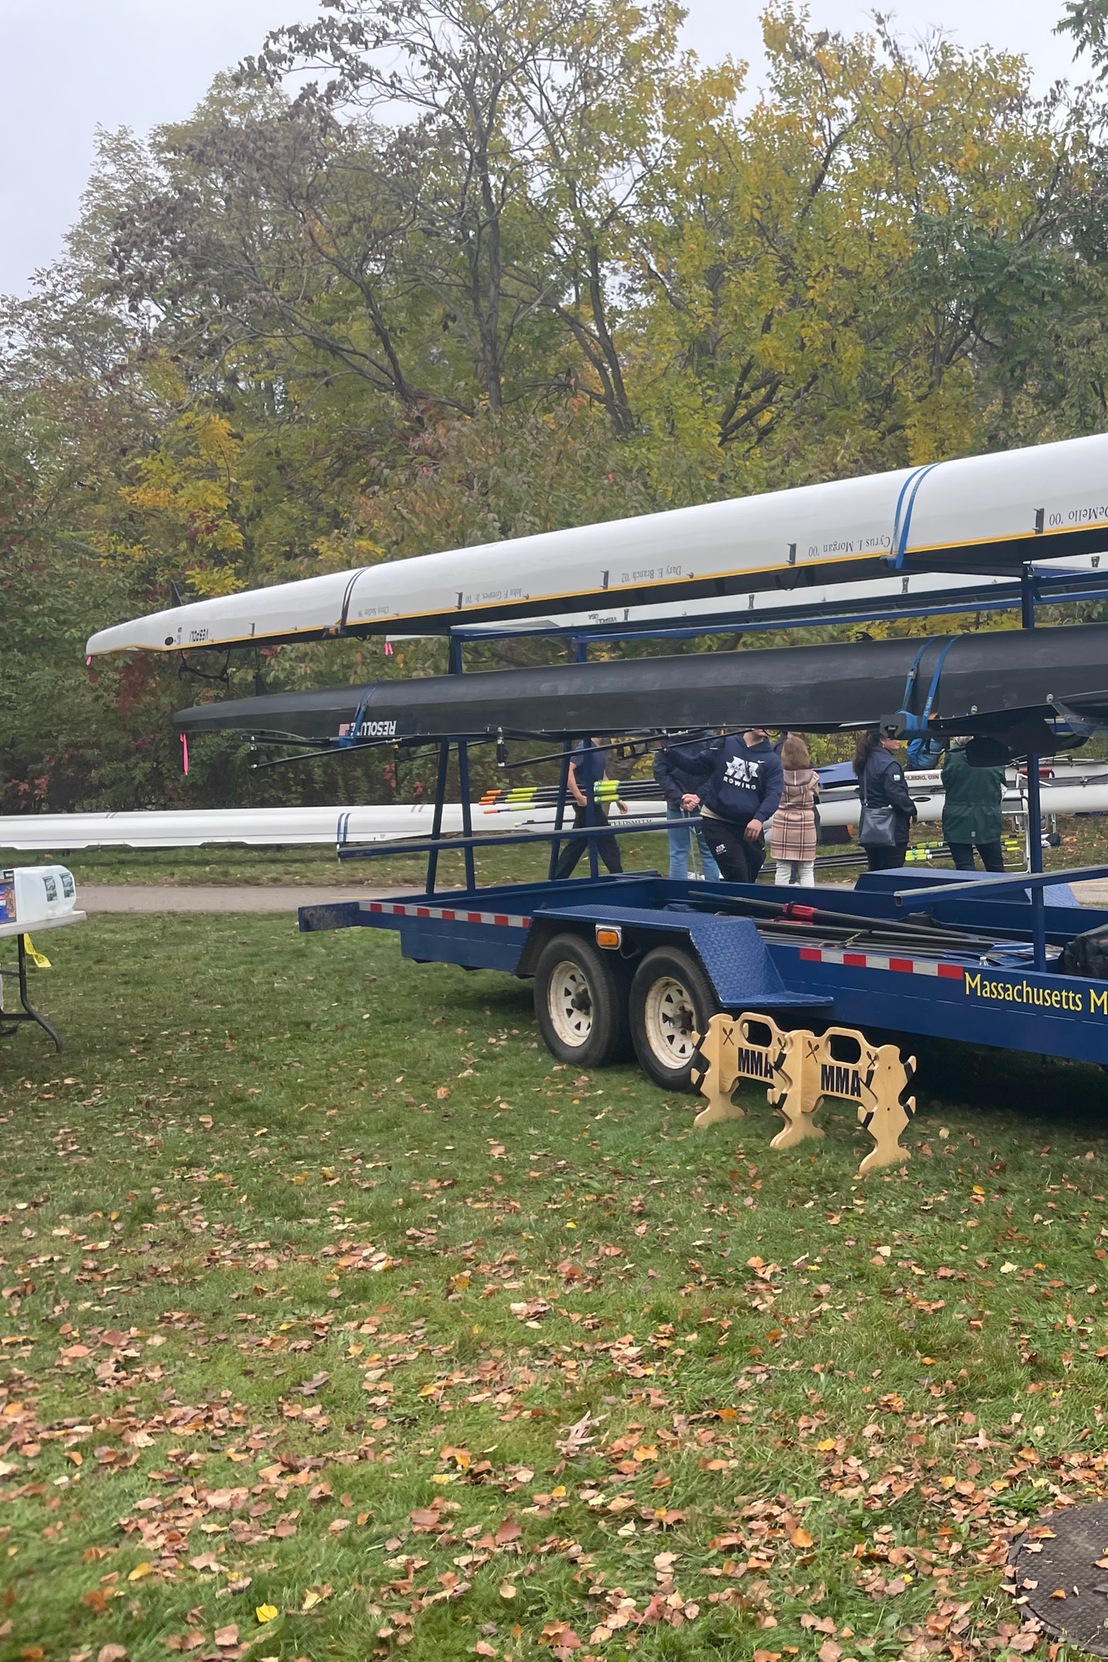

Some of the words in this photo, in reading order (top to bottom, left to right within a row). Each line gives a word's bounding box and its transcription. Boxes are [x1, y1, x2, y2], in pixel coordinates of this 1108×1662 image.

[823, 541, 854, 553] Morgan
[865, 534, 891, 549] Cyrus
[350, 720, 397, 737] RESOLUE
[722, 776, 757, 791] ROWING
[964, 972, 1083, 1012] Massachusetts
[738, 1047, 774, 1079] MMA
[820, 1063, 862, 1099] MMA
